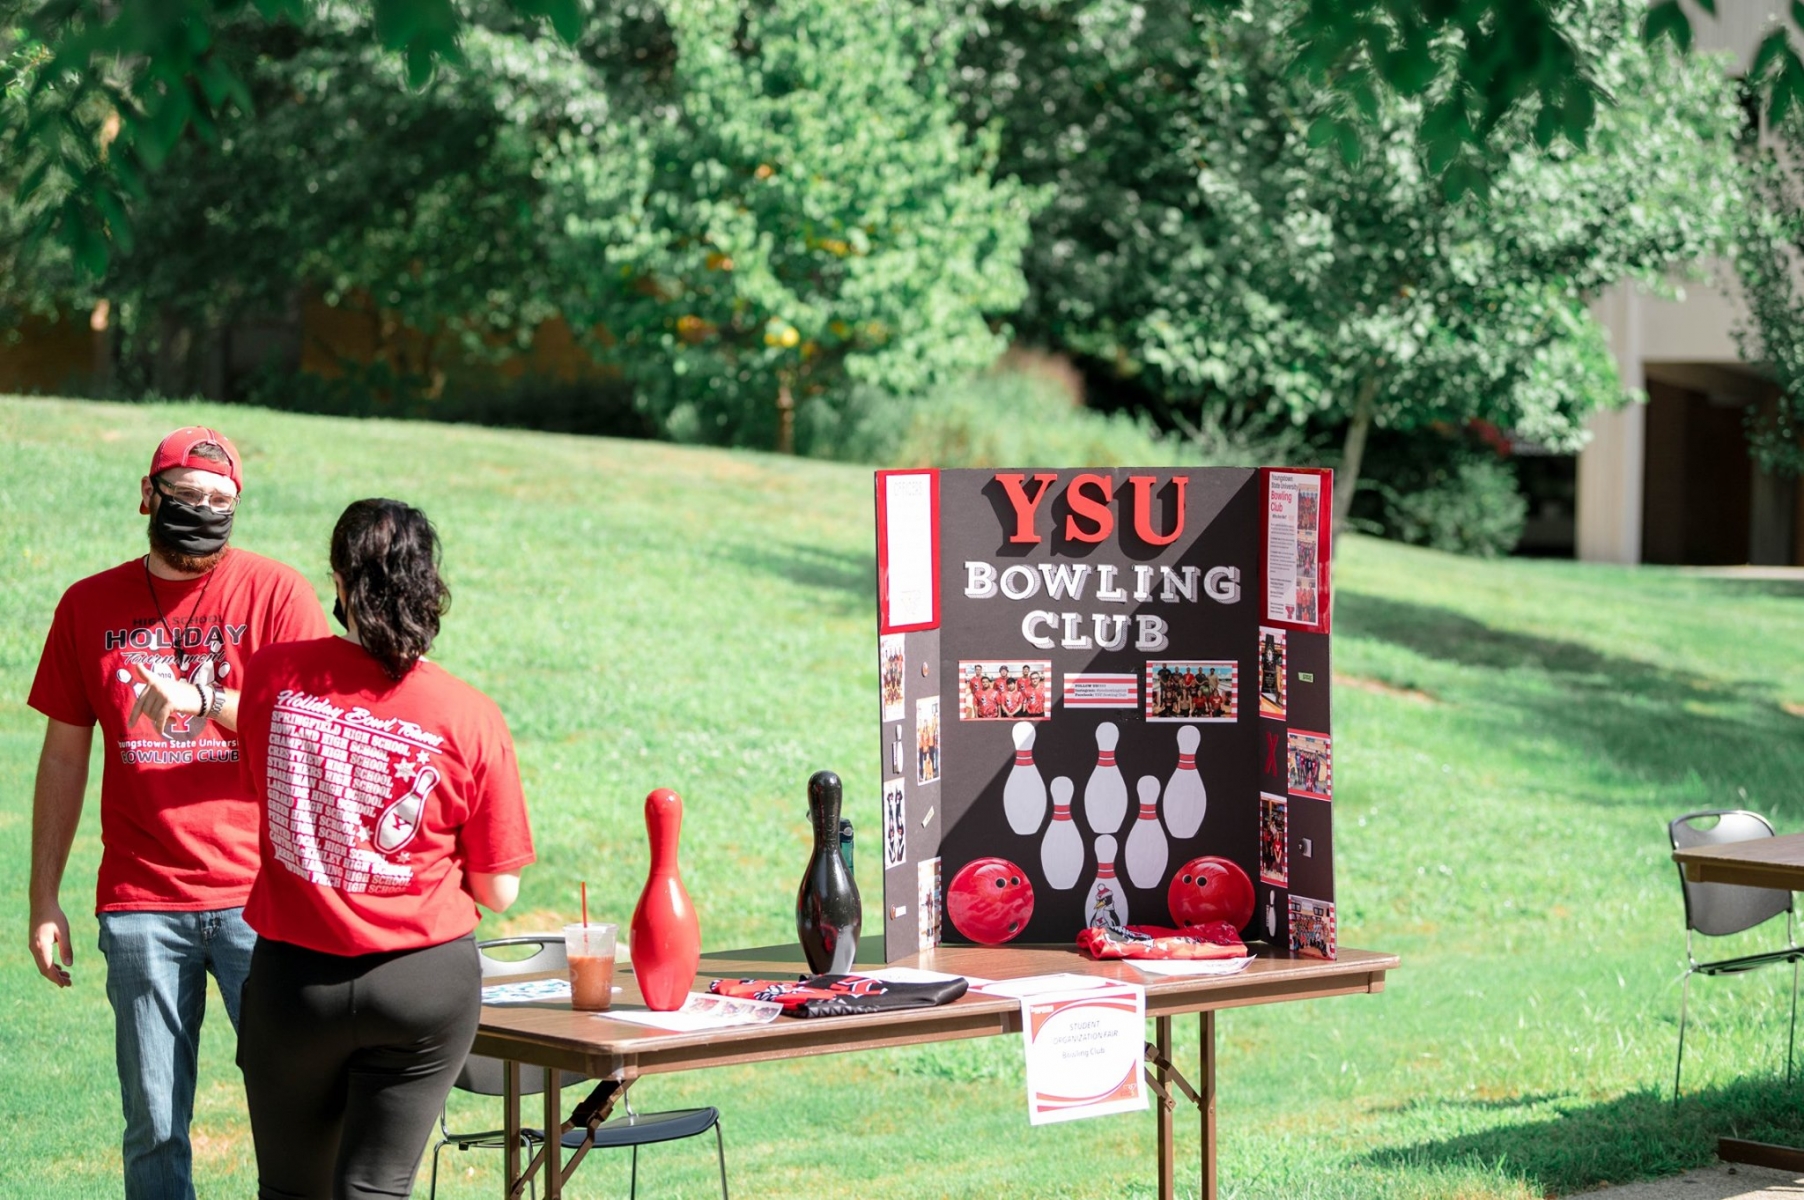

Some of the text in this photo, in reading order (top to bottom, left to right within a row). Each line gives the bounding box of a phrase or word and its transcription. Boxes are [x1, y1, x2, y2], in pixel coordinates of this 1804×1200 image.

[1271, 474, 1293, 482] Youngstown
[995, 474, 1189, 546] YSU
[1271, 491, 1292, 504] Bowling
[1271, 502, 1283, 512] Club
[963, 561, 1241, 603] BOWLING
[172, 615, 224, 625] SCHOOL
[1022, 610, 1169, 651] CLUB
[105, 624, 247, 650] HOLIDAY
[120, 651, 226, 666] Tournament
[171, 712, 194, 733] Y
[277, 690, 444, 747] Holiday Bowl Teams
[118, 738, 240, 750] ungstown State Universi
[270, 722, 390, 762] HOWLAND HIGH SCHOOL
[272, 711, 411, 757] SPRINGFIELD HIGH SCHOOL
[197, 749, 239, 762] CLUB
[268, 745, 394, 787] CRESTVIEW HIGH SCHOOL
[269, 734, 389, 774] CHAMPION HIGH SCHOOL
[267, 756, 392, 799] STRUTHERS HIGH SCHOOL
[267, 767, 384, 808] BOARDMAN HIGH SCHOOL
[296, 798, 324, 814] HIGH
[325, 805, 362, 826] SCHOOL
[311, 789, 336, 806] HIGH
[336, 797, 376, 818] SCHOOL
[291, 809, 318, 824] HIGH
[319, 815, 356, 835] SCHOOL
[392, 813, 412, 830] Y
[292, 832, 321, 849] LOCAL
[323, 838, 347, 857] HIGH
[318, 826, 356, 847] SCHOOL
[302, 858, 343, 877] HARDING
[344, 868, 370, 883] HIGH
[371, 874, 411, 887] SCHOOL
[343, 857, 370, 872] HIGH
[371, 861, 413, 877] SCHOOL
[342, 879, 367, 893] HIGH
[368, 884, 406, 894] SCHOOL
[1053, 1029, 1119, 1045] ORGANIZATION FAIR
[1069, 1020, 1100, 1031] STUDENT
[1062, 1046, 1105, 1059] Bowling Club
